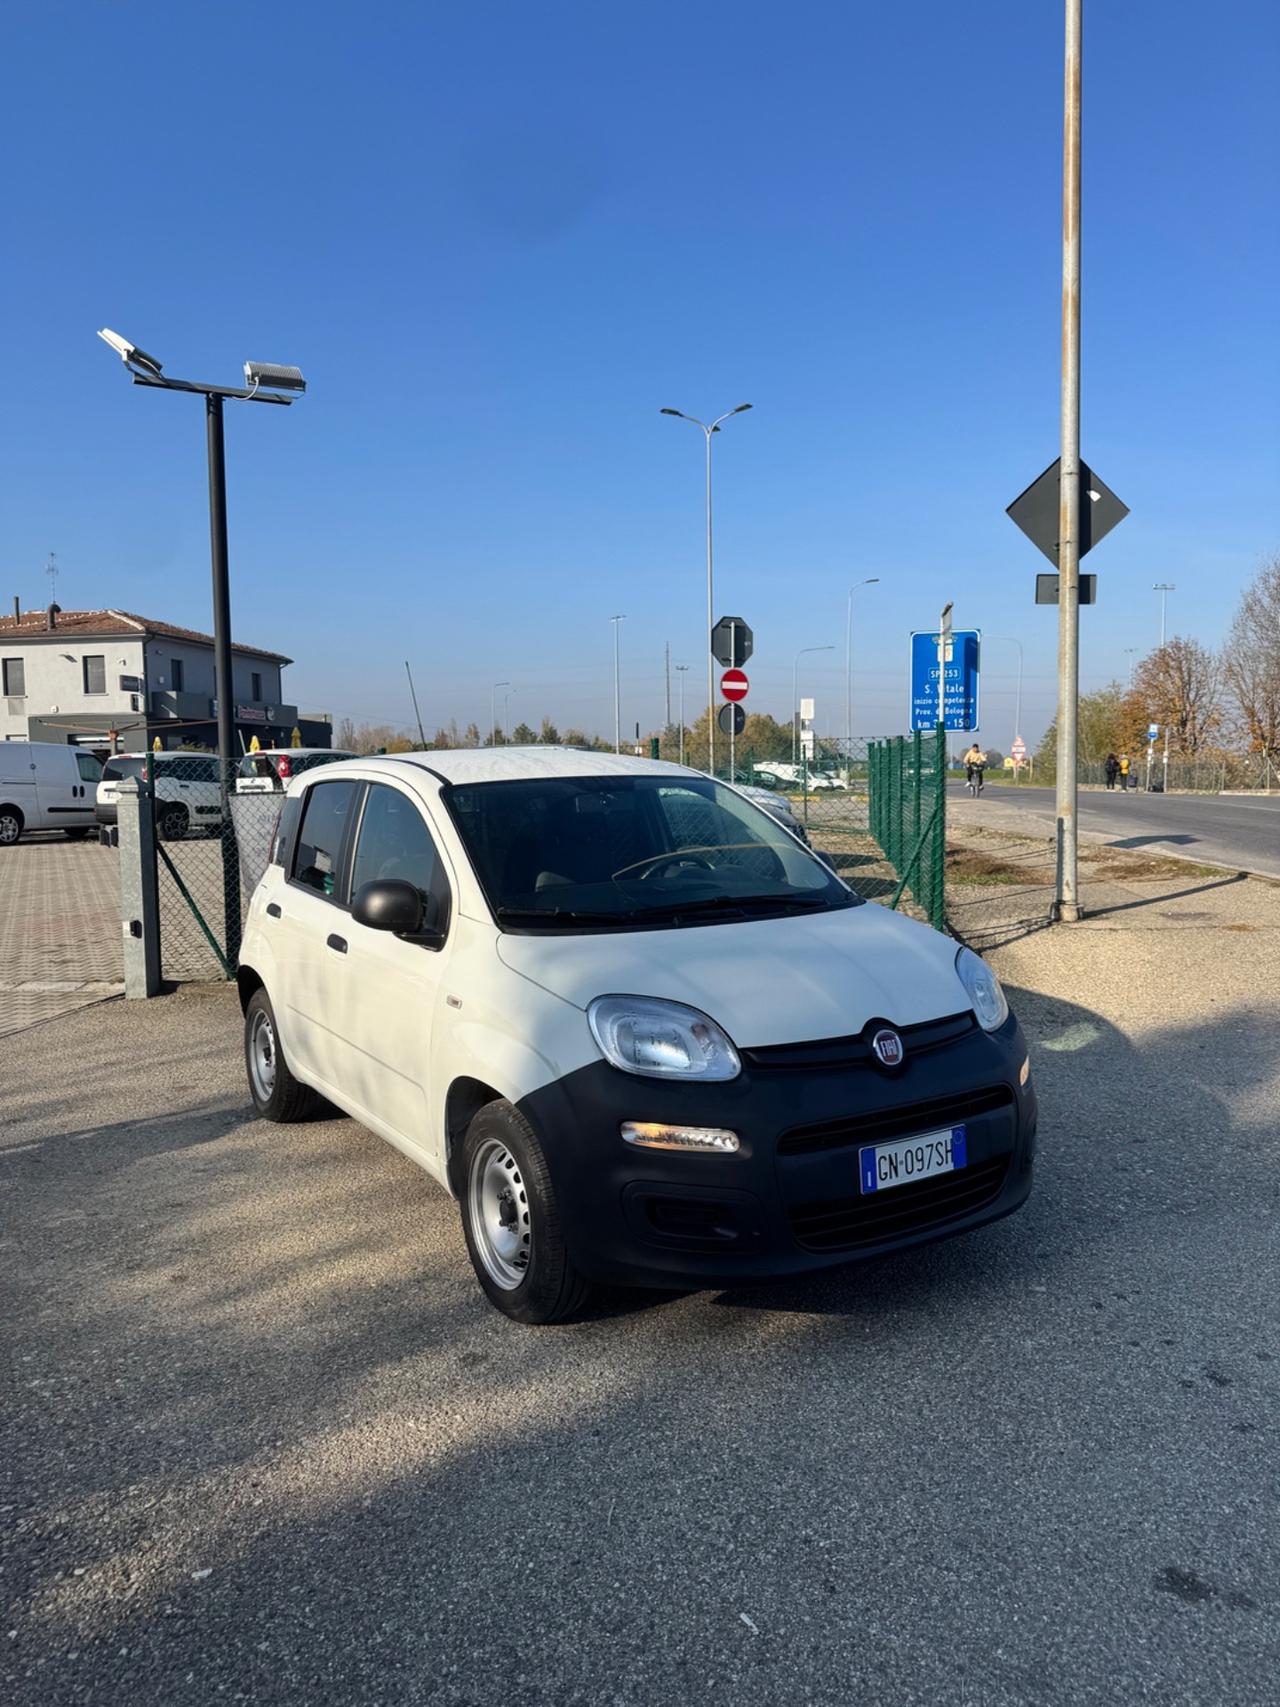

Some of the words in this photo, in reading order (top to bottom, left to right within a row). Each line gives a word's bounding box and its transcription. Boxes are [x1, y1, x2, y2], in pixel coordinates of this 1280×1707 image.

[924, 684, 934, 694] S.
[913, 697, 933, 705] inizio
[915, 708, 933, 716] Prov.
[917, 719, 931, 729] km
